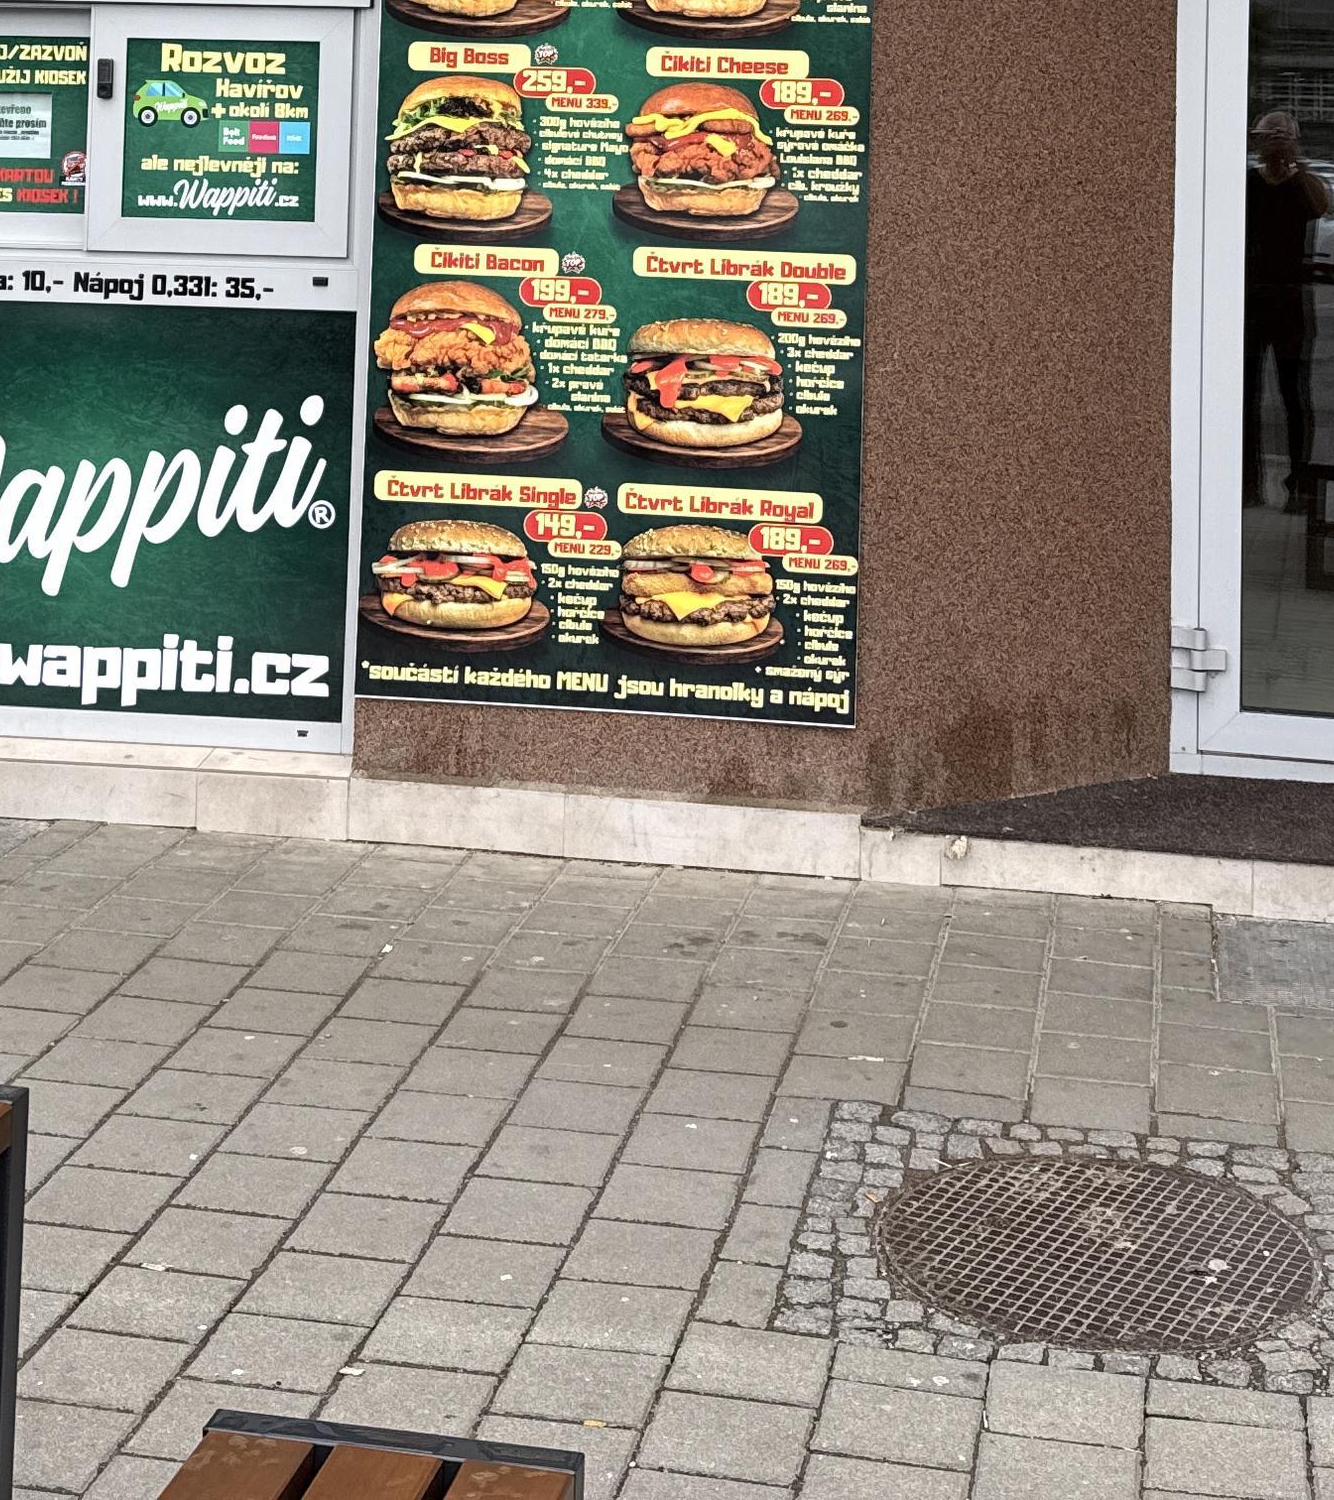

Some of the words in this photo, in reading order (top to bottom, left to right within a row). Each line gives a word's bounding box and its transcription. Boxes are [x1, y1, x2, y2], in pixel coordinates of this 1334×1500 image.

[161, 42, 286, 75] Rozvoz
[429, 47, 458, 67] Big
[463, 48, 510, 66] Boss
[661, 52, 711, 74] Čikiti
[717, 56, 789, 75] Cheese
[35, 70, 86, 85] KIOSEK
[216, 78, 303, 99] Havířov
[521, 68, 587, 94] 259,-
[771, 81, 832, 106] 189,-
[211, 104, 226, 118] +
[229, 102, 270, 118] okolí
[275, 103, 309, 119] 8km
[141, 154, 169, 171] ale
[173, 155, 266, 178] nejlevněji
[272, 161, 299, 174] na:
[430, 246, 481, 270] Čikiti
[485, 253, 545, 272] Bacon
[646, 251, 704, 275] Čtvrt
[710, 255, 775, 279] Librák
[780, 261, 847, 281] Double
[73, 271, 146, 301] Nápoj
[530, 279, 591, 305] 199,-
[758, 282, 819, 308] 189,-
[387, 475, 446, 500] Čtvrt
[450, 479, 514, 502] Librák
[519, 486, 578, 509] Single
[625, 488, 683, 512] Čtvrt
[689, 493, 754, 516] Librák
[759, 501, 815, 523] Royal
[536, 513, 596, 540] 149,-
[759, 527, 822, 553] 189,-
[464, 664, 551, 691] každého
[557, 672, 609, 693] MENU
[614, 678, 664, 700] jsou
[670, 679, 765, 709] hranolky
[770, 690, 783, 705] a
[788, 688, 851, 714] nápoj
